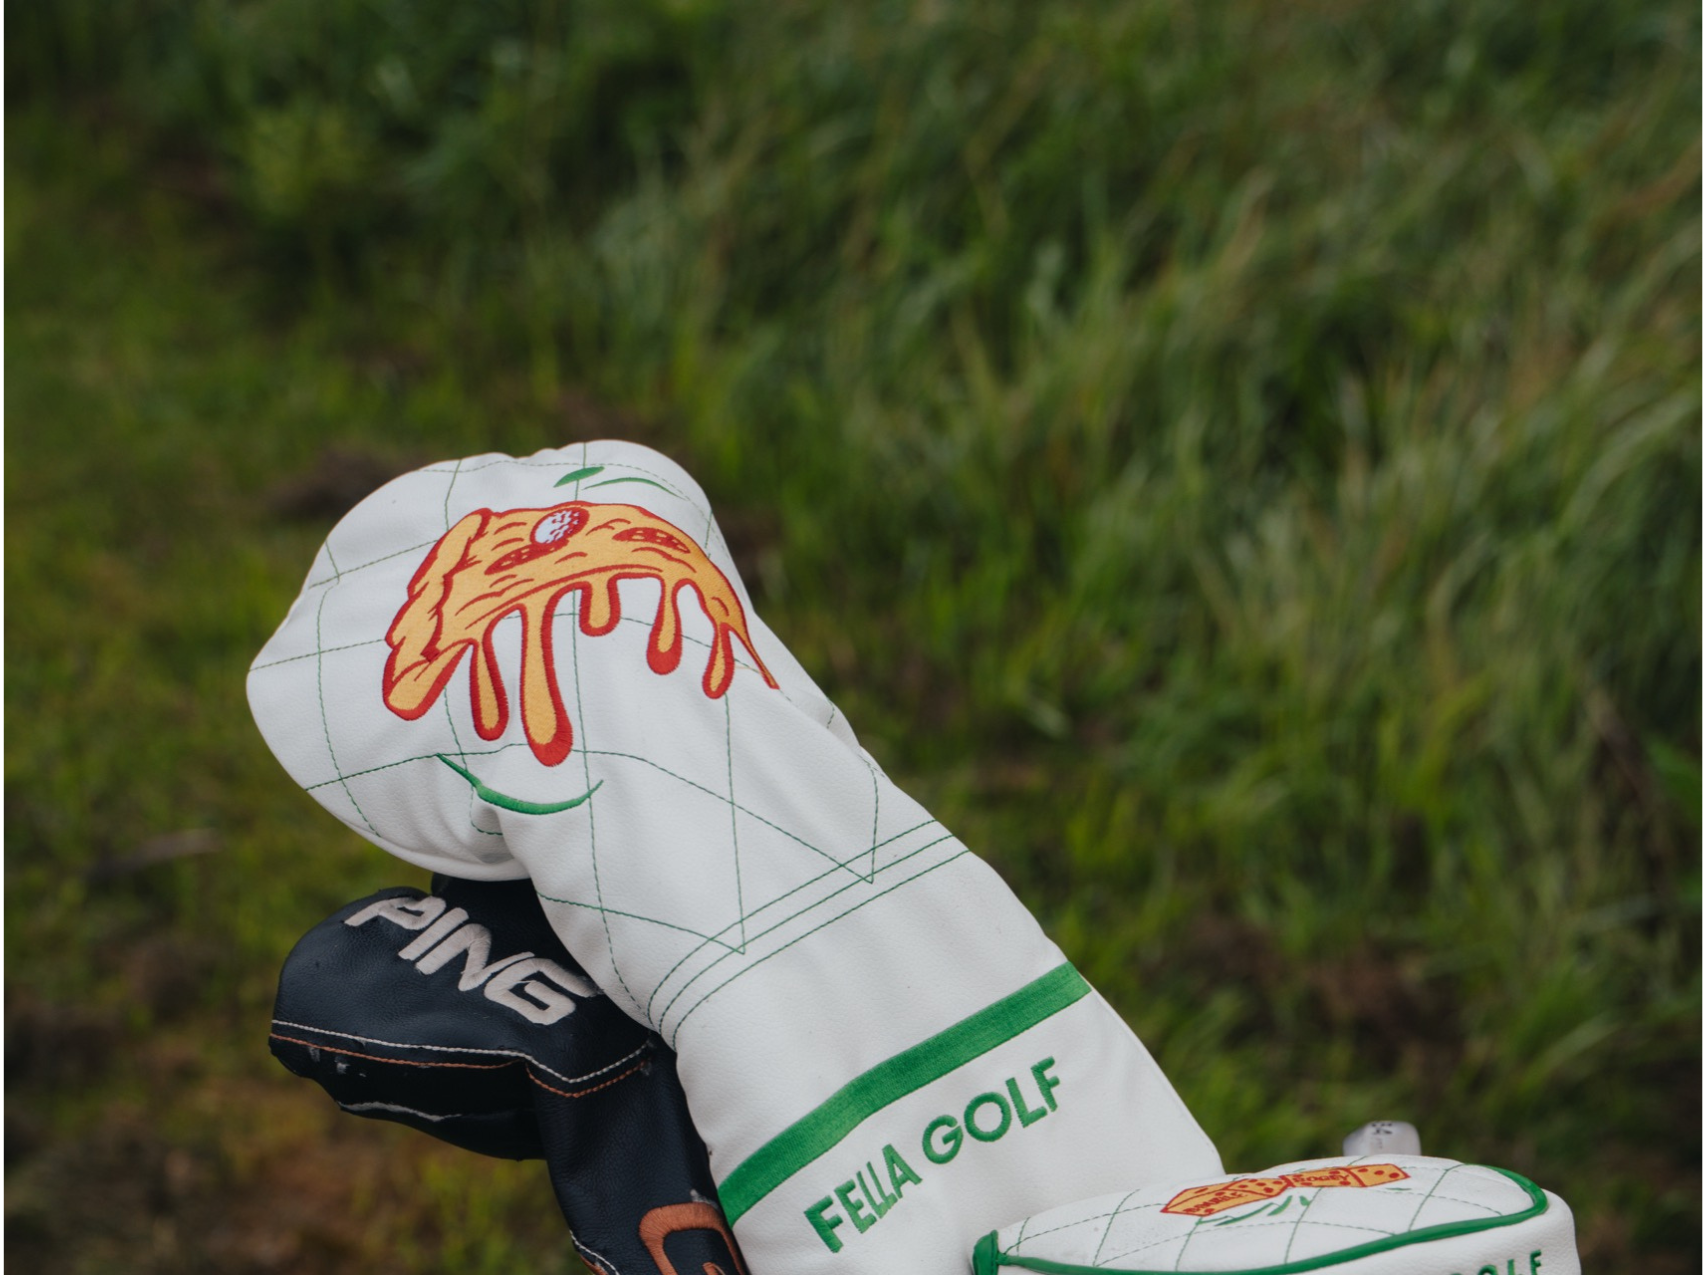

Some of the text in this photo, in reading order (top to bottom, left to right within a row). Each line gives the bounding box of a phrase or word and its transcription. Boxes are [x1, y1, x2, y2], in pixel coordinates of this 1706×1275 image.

[344, 896, 601, 1025] PING
[804, 1056, 1060, 1253] FELLA GOLF
